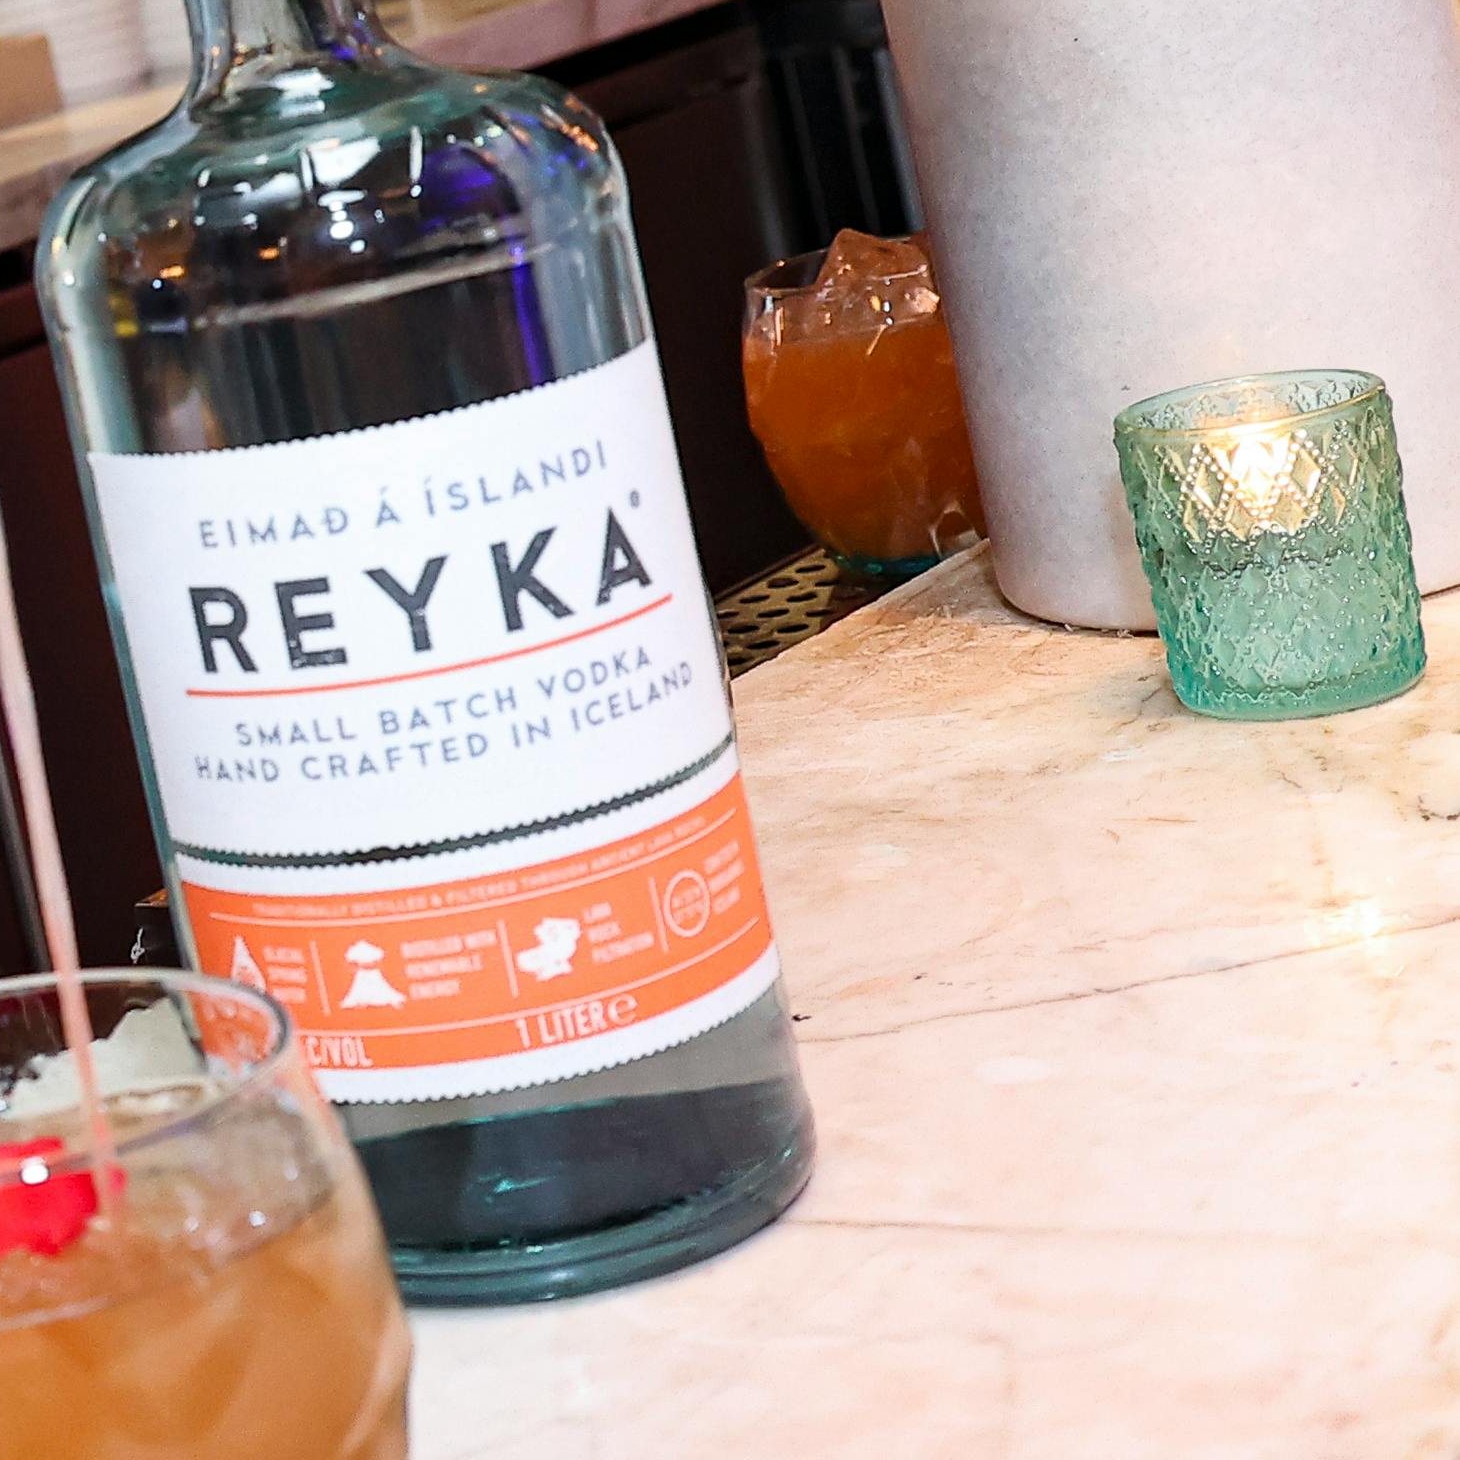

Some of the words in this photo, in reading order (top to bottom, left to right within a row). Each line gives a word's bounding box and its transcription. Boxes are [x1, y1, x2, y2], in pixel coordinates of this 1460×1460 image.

[194, 755, 280, 783] HAND
[300, 732, 490, 781] CRAFTED
[511, 716, 552, 749] IN
[570, 661, 693, 732] ICELAND
[235, 718, 357, 747] SMALL
[377, 685, 517, 736] BATCH
[536, 647, 653, 700] VODKA
[516, 1018, 531, 1048] 1
[538, 1003, 607, 1042] LITER
